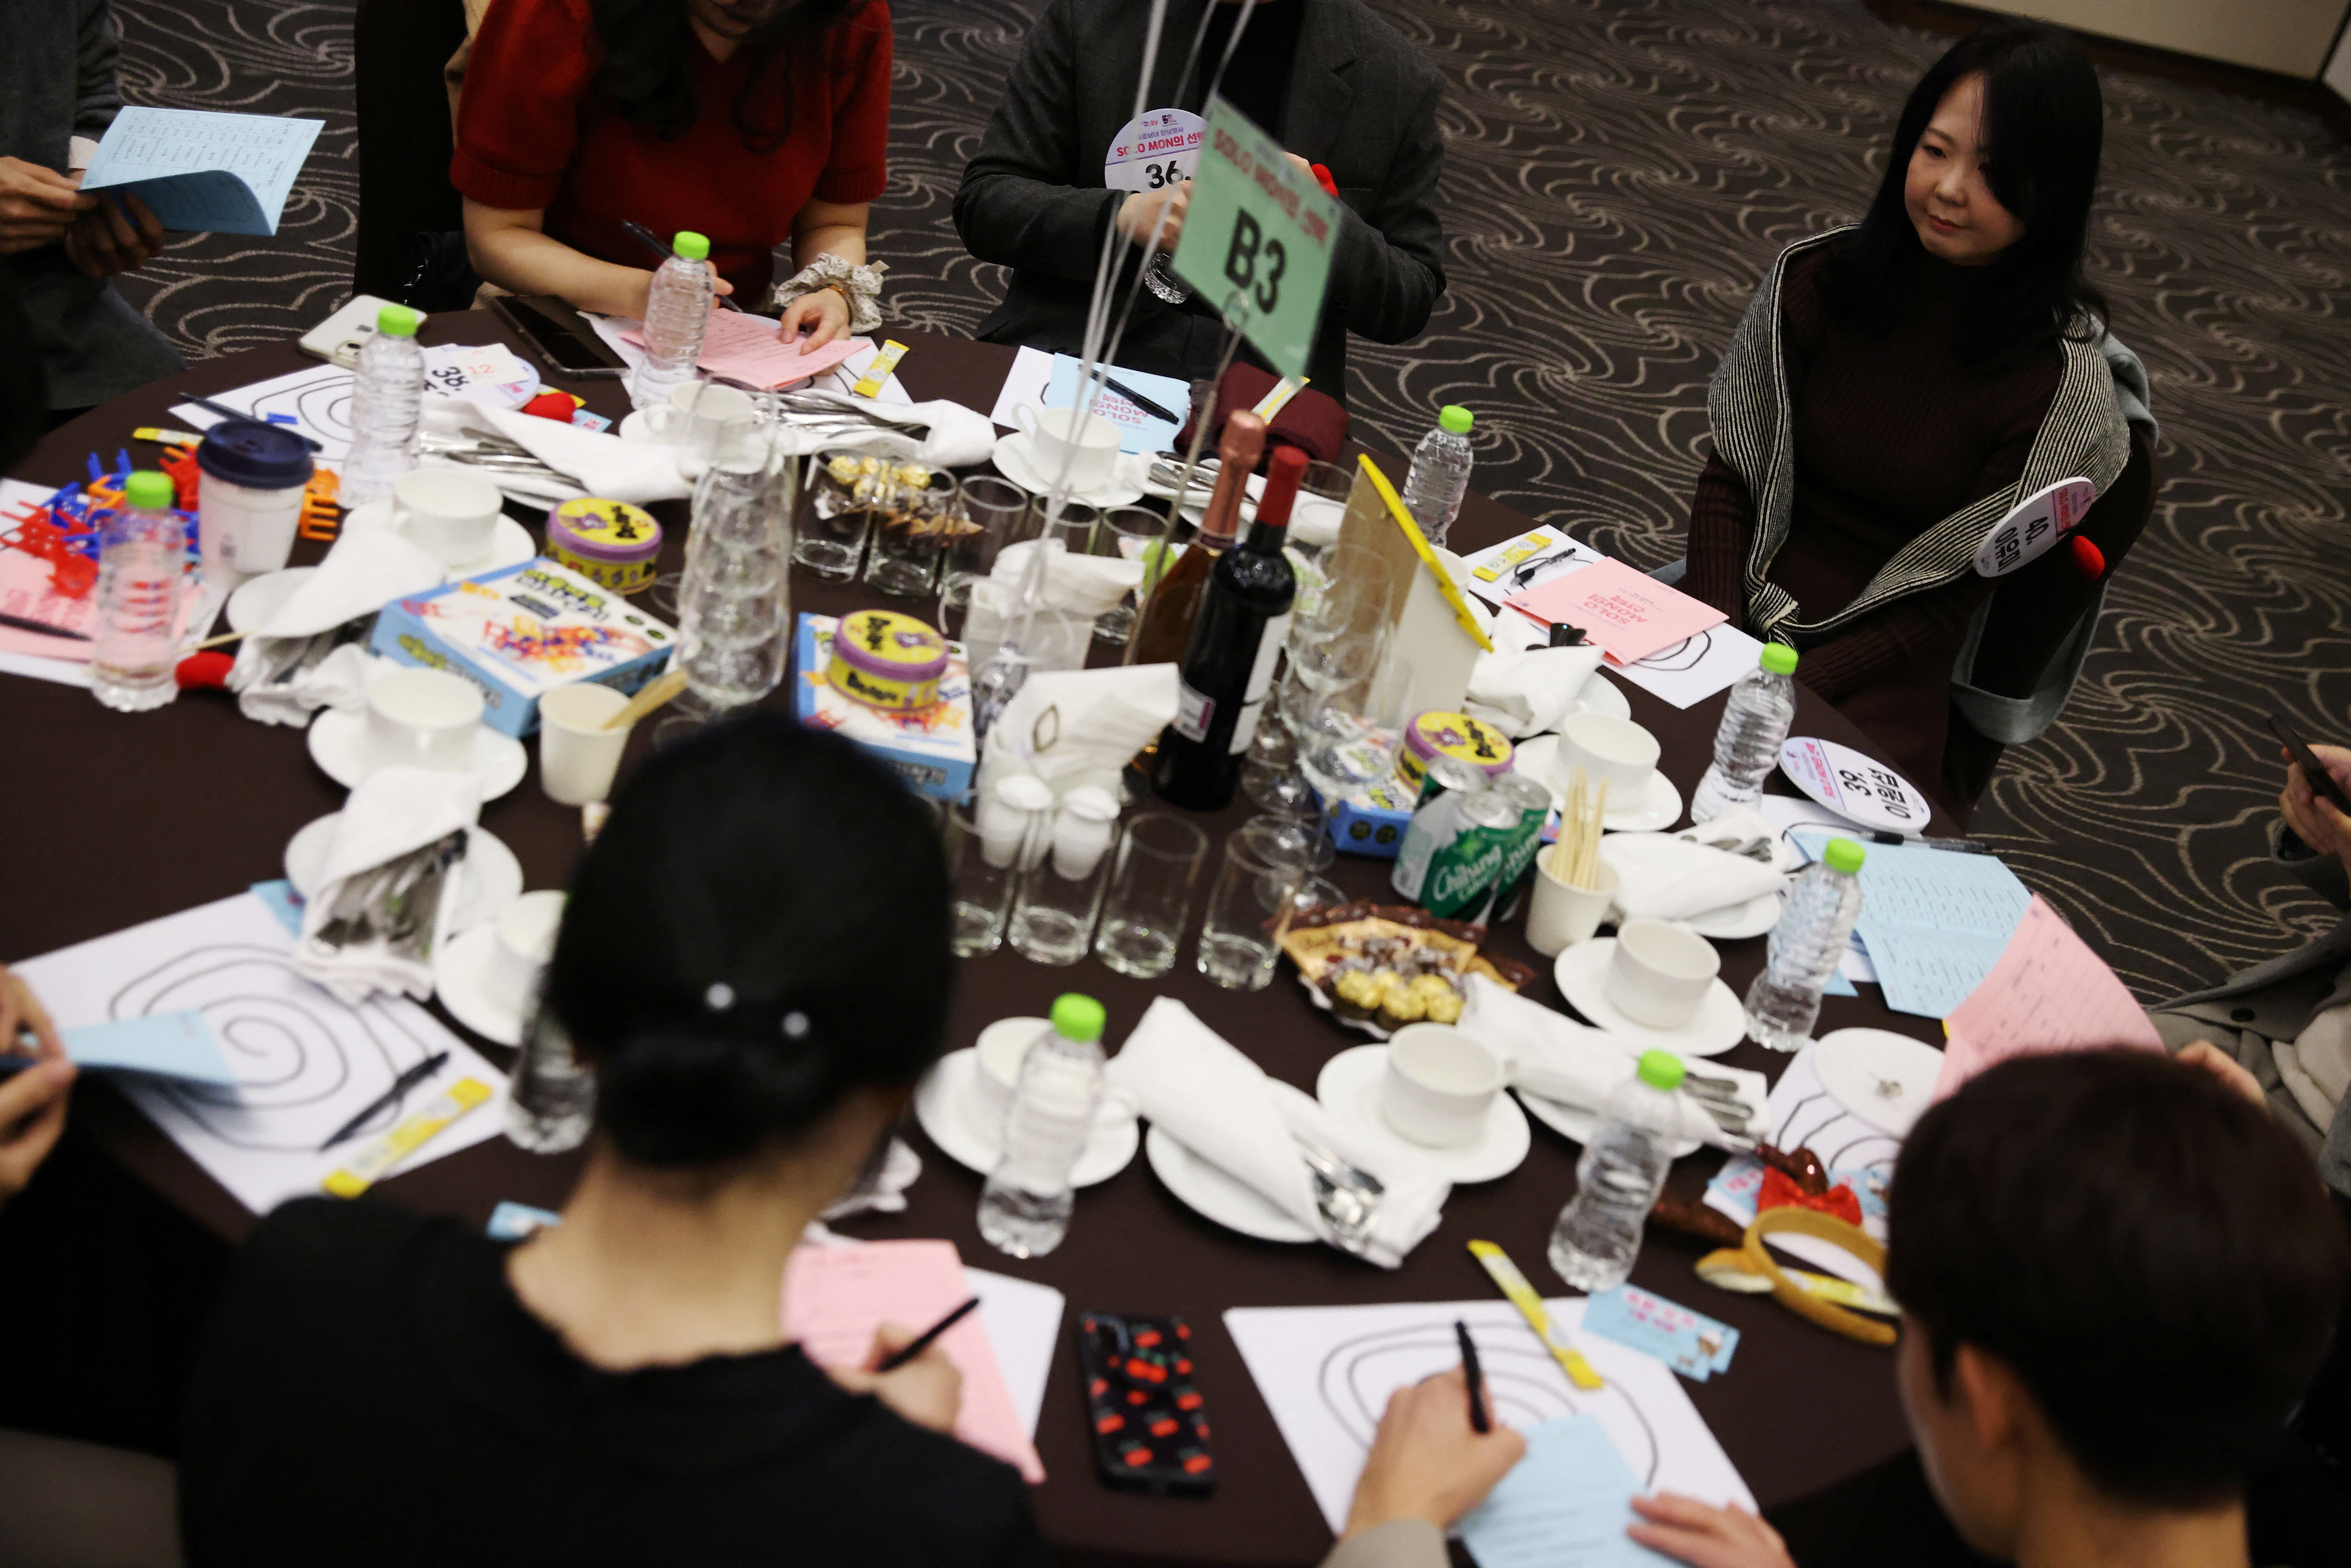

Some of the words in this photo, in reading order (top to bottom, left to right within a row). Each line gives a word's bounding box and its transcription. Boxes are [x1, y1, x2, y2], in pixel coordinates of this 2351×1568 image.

[1117, 143, 1146, 157] SOO
[1148, 135, 1185, 151] MON의
[1224, 208, 1286, 313] B3
[1093, 409, 1141, 424] SOLO
[2025, 516, 2049, 545] 40.
[1995, 527, 2020, 572] 이유미
[1584, 602, 1630, 624] SOLO
[1839, 769, 1871, 797] 39.
